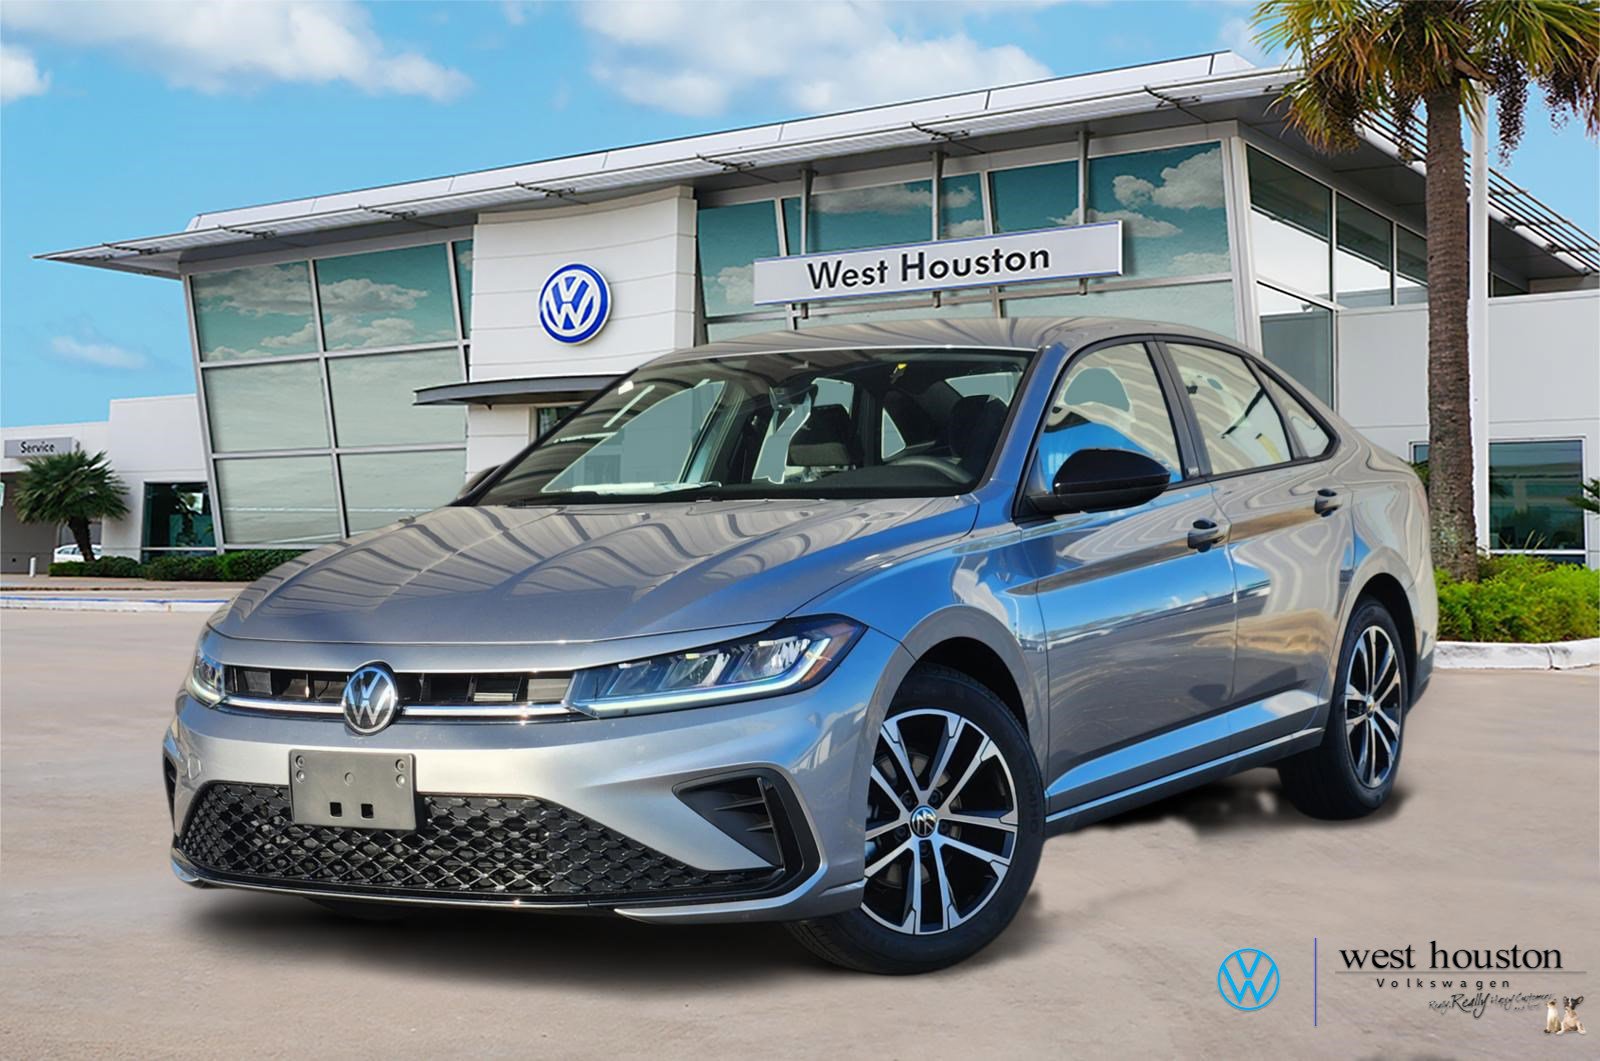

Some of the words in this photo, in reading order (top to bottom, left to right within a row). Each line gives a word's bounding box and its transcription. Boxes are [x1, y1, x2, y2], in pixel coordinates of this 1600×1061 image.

[807, 259, 888, 290] West
[901, 247, 1050, 282] Houston
[542, 268, 603, 338] VW
[20, 441, 56, 454] Service
[345, 668, 395, 731] VW
